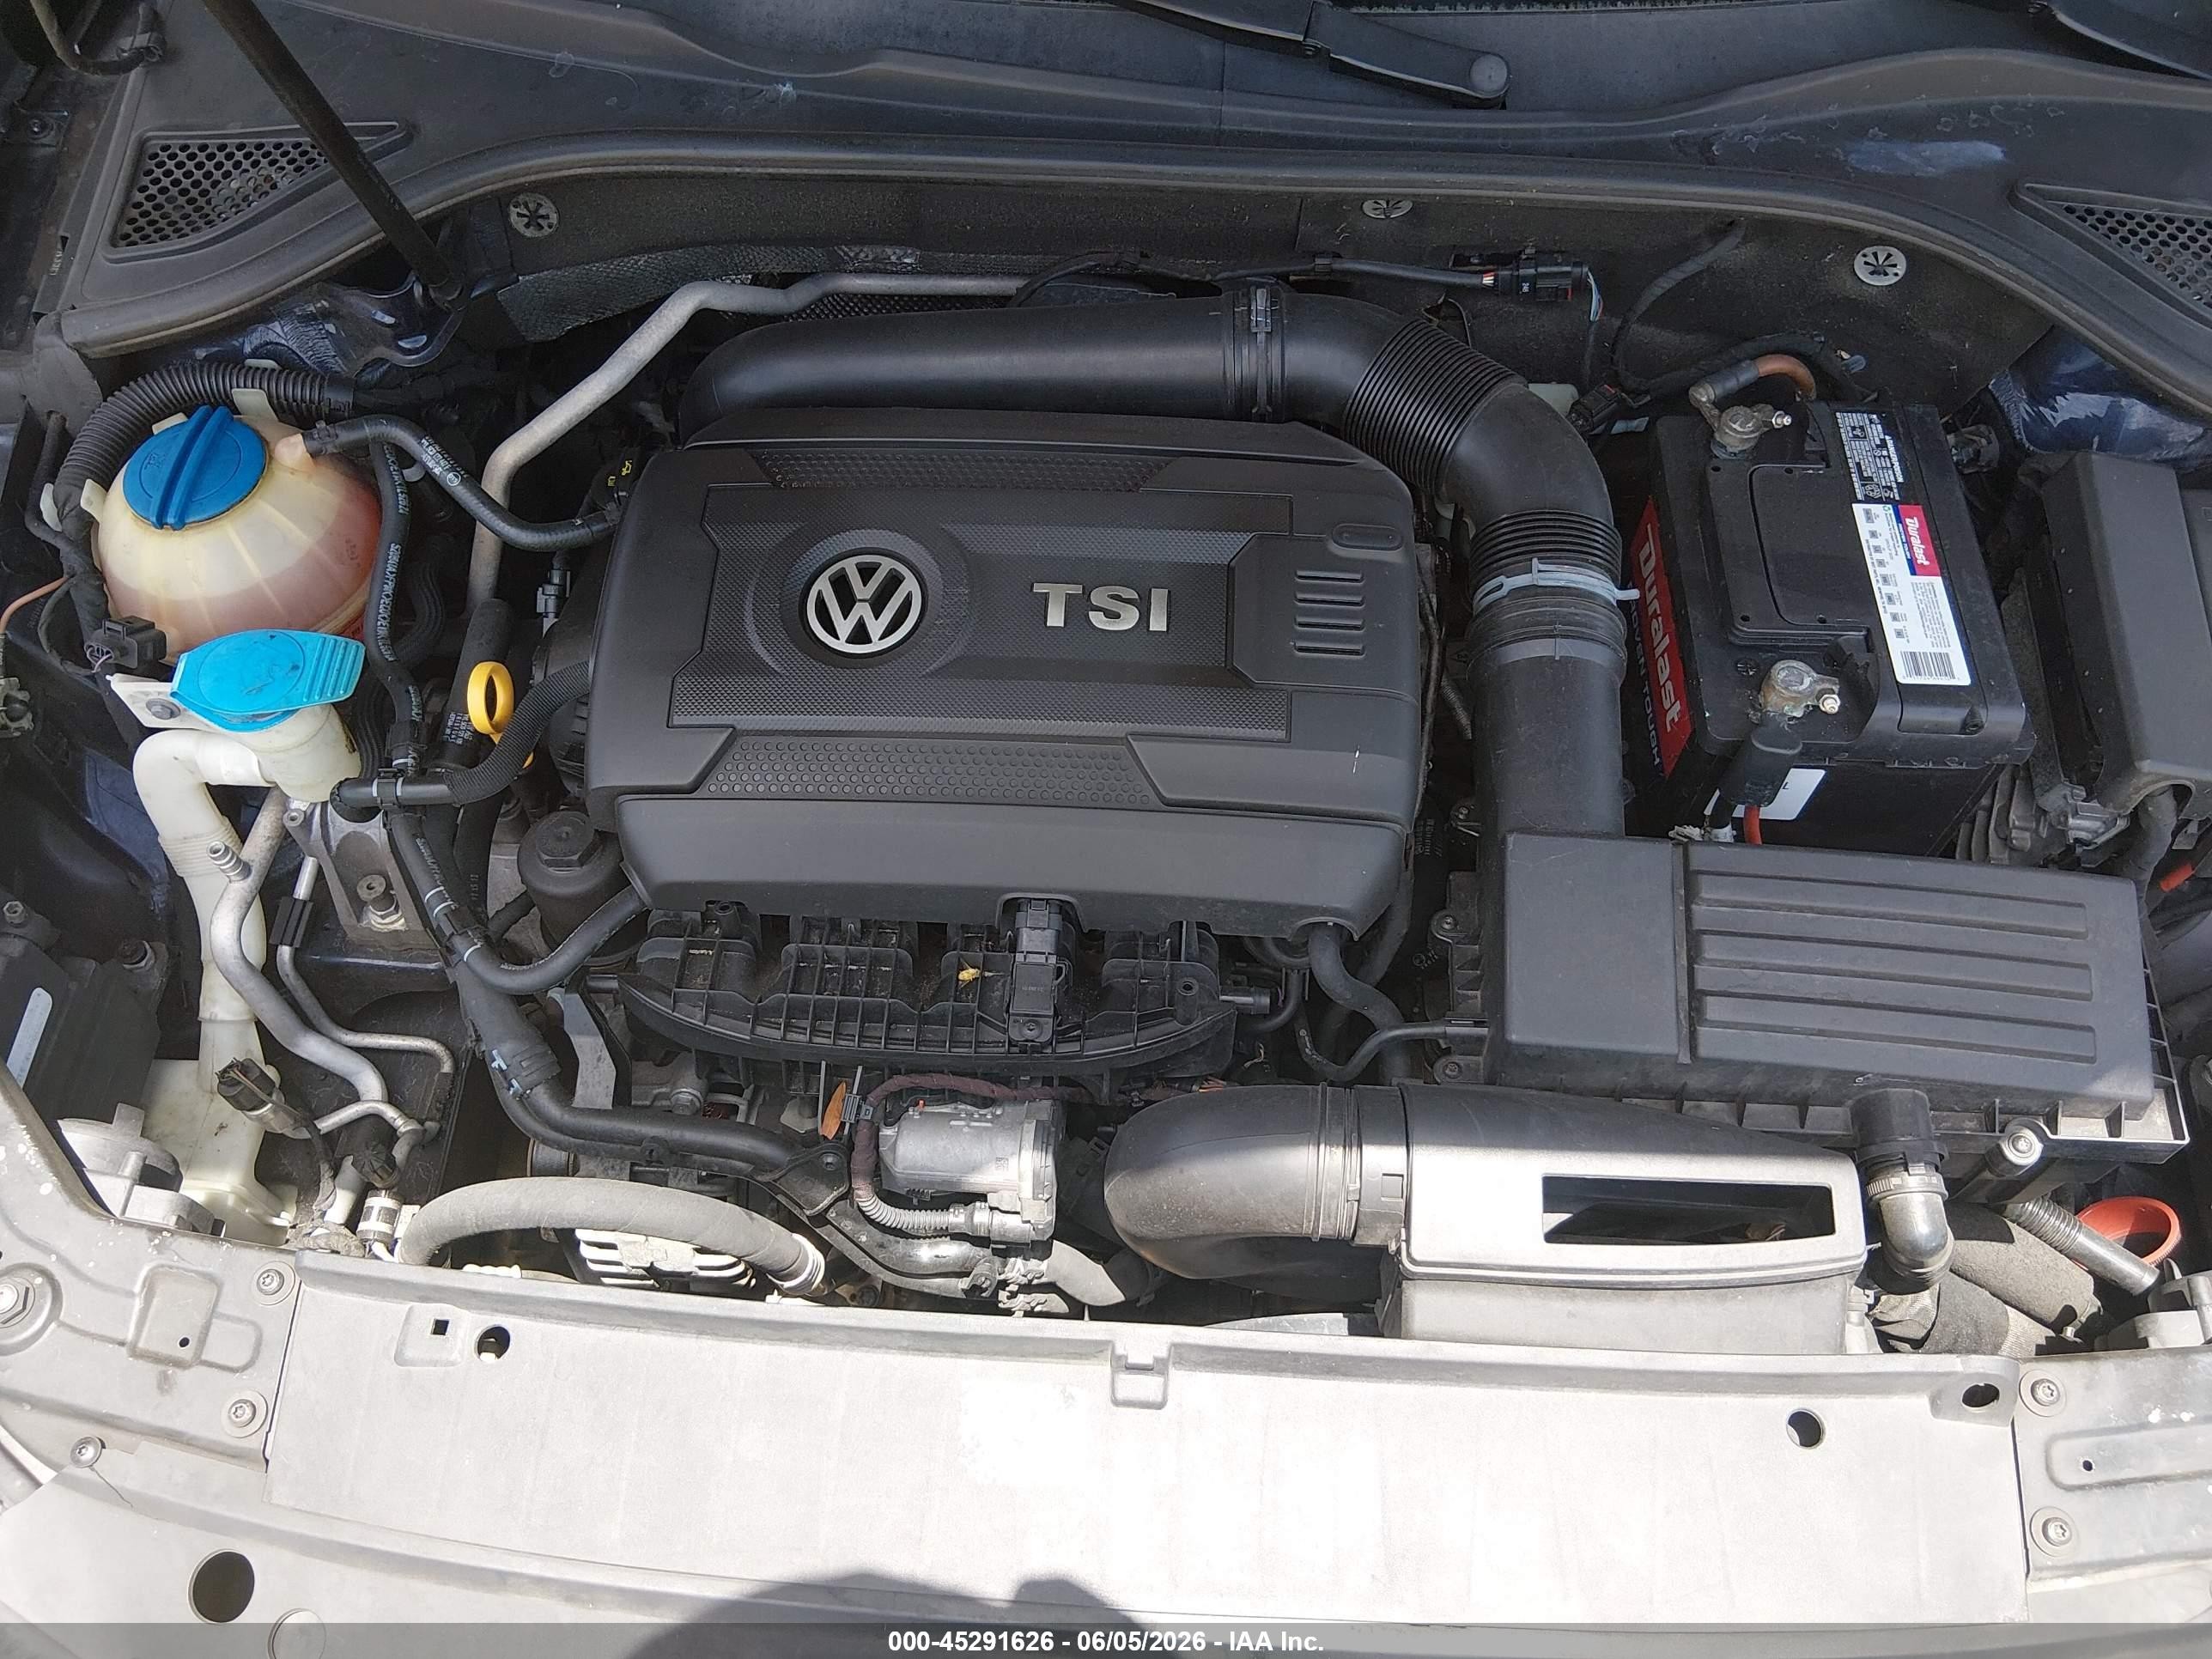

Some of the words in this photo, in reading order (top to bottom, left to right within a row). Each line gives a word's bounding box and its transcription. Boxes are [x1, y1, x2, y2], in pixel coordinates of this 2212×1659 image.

[1905, 517, 1930, 566] Duralast
[1032, 582, 1170, 632] TSI
[1638, 523, 1681, 732] Duralast
[1643, 685, 1661, 767] TOUGH
